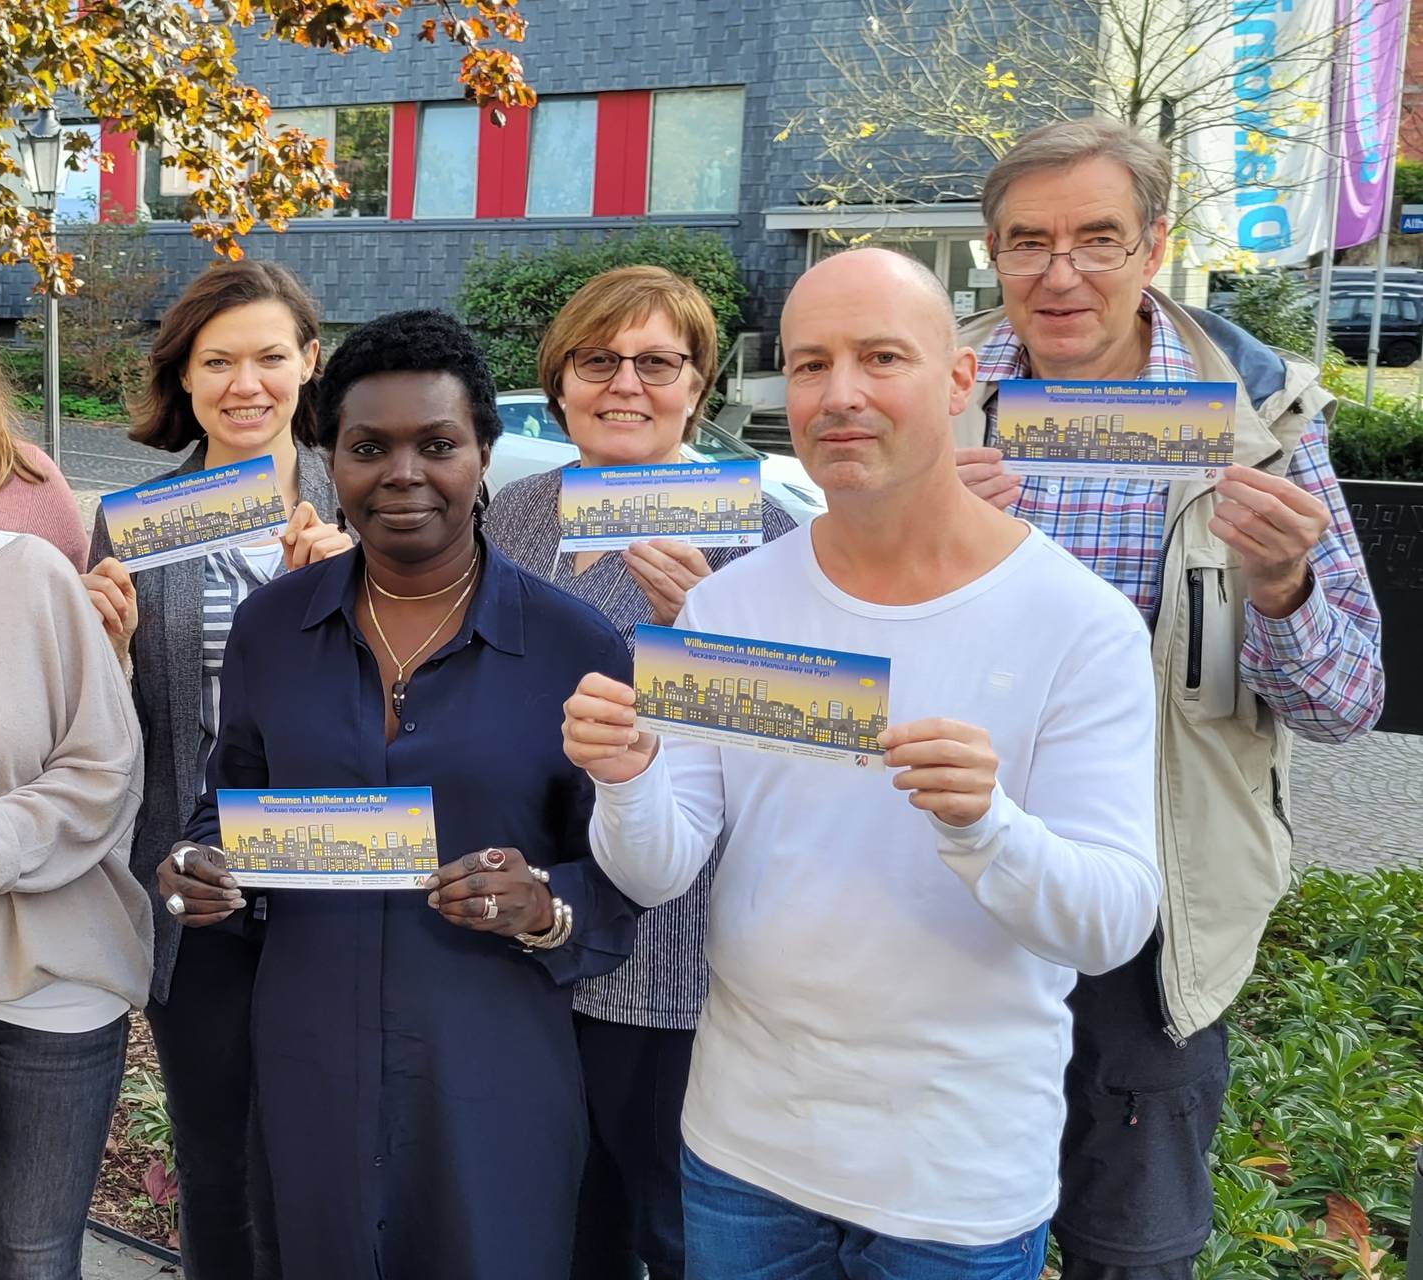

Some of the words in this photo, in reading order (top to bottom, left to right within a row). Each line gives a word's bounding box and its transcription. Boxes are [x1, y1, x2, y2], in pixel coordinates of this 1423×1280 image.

[1044, 386, 1092, 394] Willkommen
[1104, 387, 1139, 395] Mülheim
[1152, 387, 1165, 395] der
[601, 471, 641, 479] Willkommen
[651, 469, 680, 477] Mülheim
[135, 486, 172, 499] Willkommen
[179, 477, 205, 488] Mülheim
[225, 468, 239, 477] Ruhr
[683, 637, 734, 653] Willkommen
[737, 645, 745, 654] in
[747, 646, 784, 660] Mülheim
[786, 654, 797, 662] an
[799, 654, 813, 664] der
[815, 656, 837, 667] Ruhr
[258, 797, 302, 805] Willkommen
[303, 796, 311, 804] in
[312, 796, 343, 804] Mülheim
[355, 795, 367, 803] der
[369, 795, 387, 803] Ruhr
